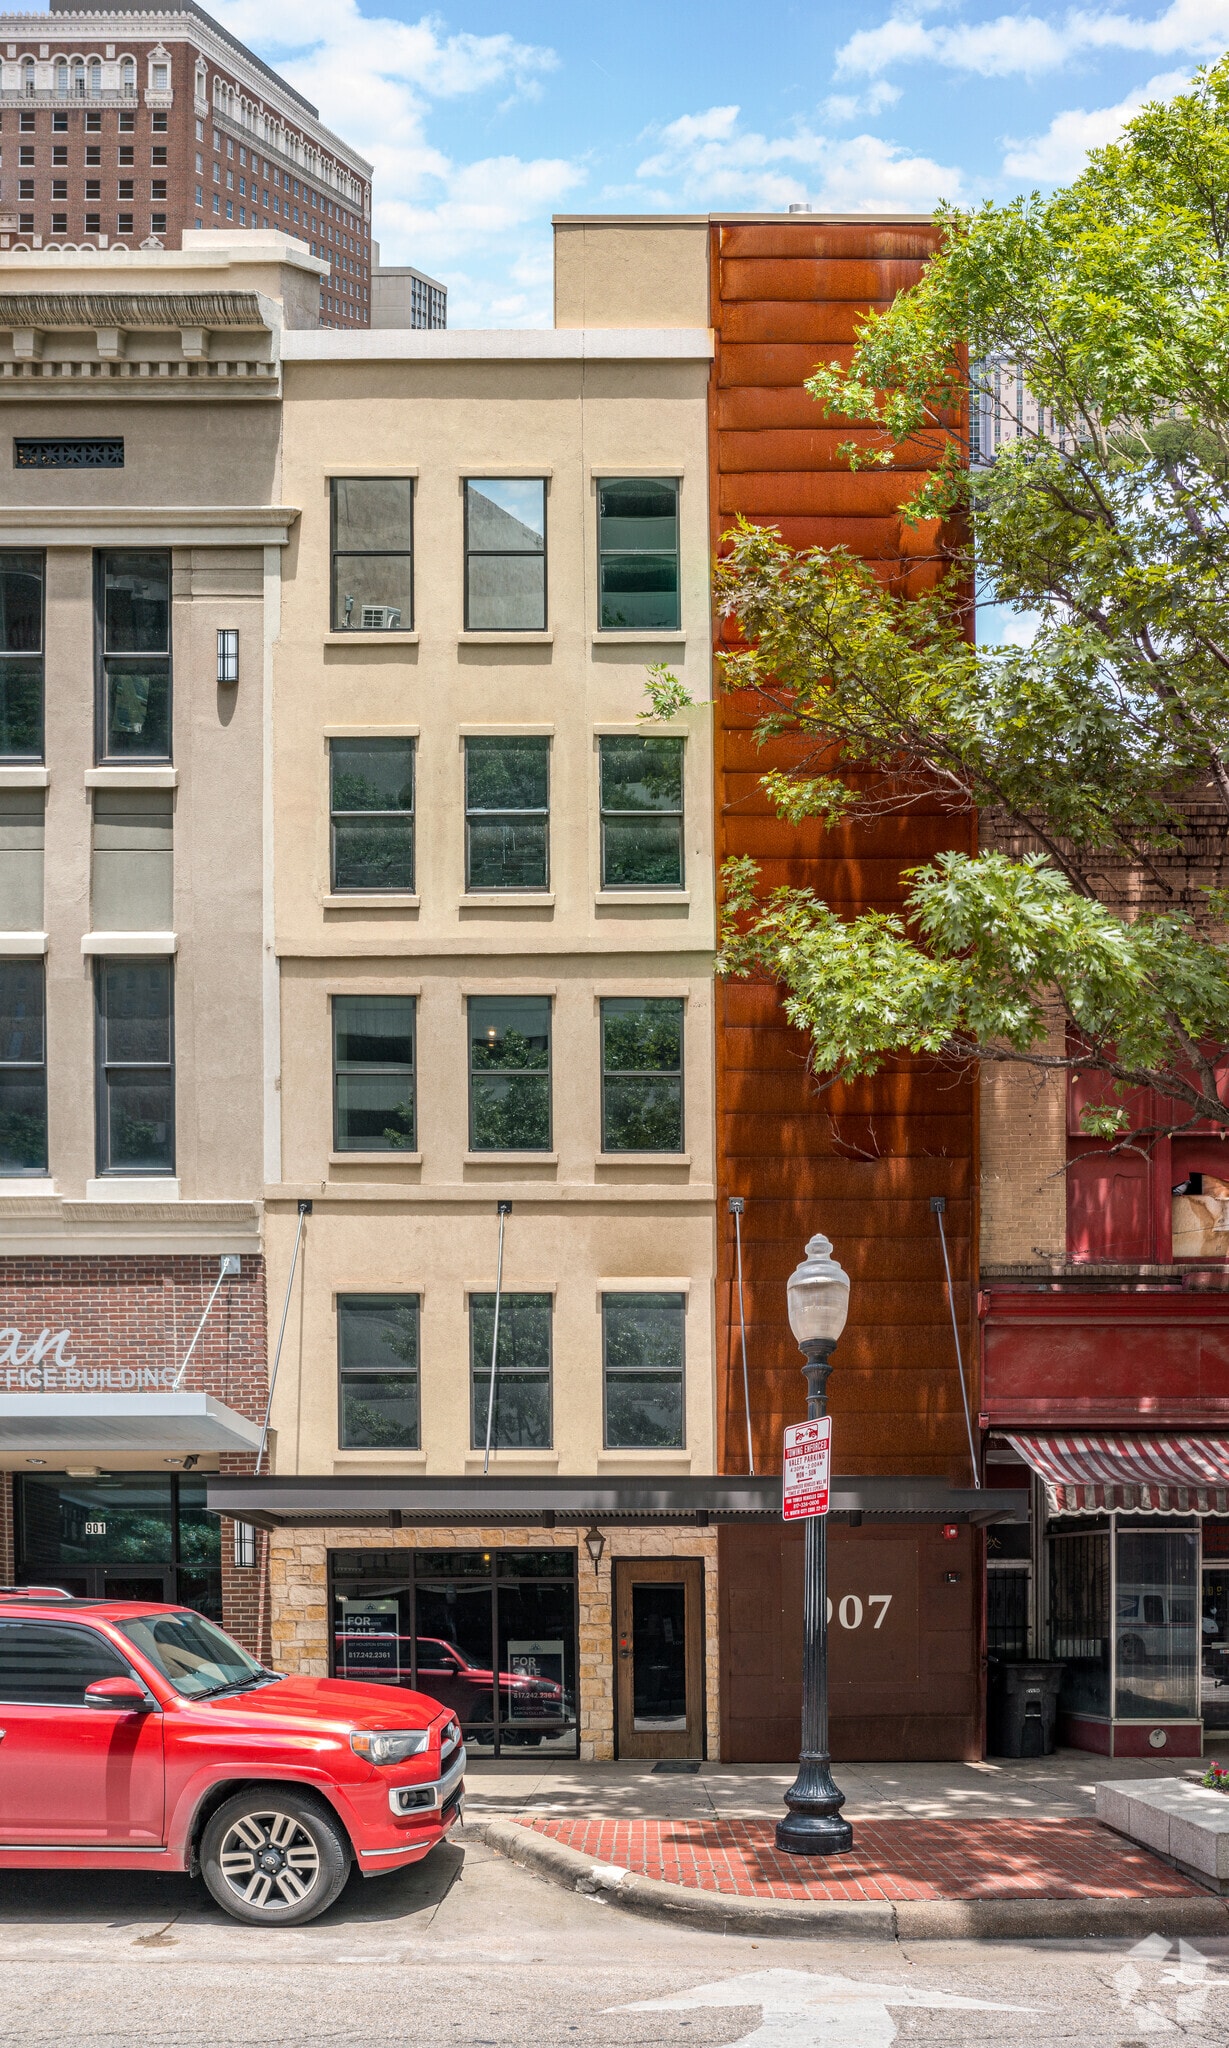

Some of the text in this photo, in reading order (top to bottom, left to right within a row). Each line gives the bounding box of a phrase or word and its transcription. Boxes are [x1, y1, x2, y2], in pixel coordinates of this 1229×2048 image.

[66, 1367, 178, 1388] BUILDING
[789, 1452, 825, 1466] VALET PARKING
[87, 1523, 105, 1533] 901
[826, 1594, 893, 1629] 07
[347, 1616, 371, 1626] FOR
[347, 1627, 376, 1637] SALE
[513, 1657, 536, 1666] FOR
[513, 1668, 541, 1677] SALE
